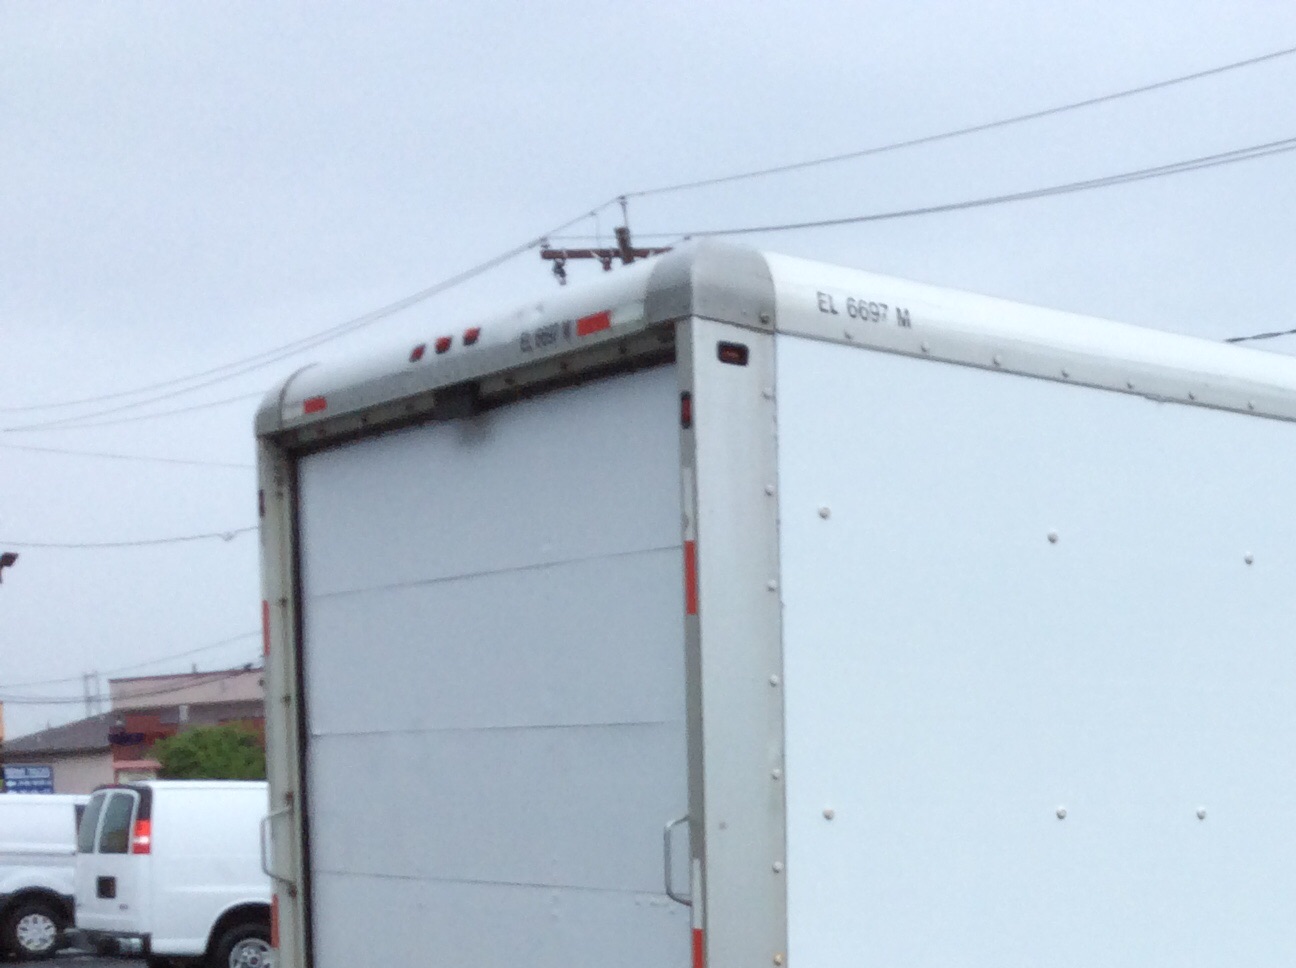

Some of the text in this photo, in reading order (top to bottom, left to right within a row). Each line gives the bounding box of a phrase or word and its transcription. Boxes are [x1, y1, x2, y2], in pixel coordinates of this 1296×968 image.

[817, 291, 911, 328] EL 6697 M
